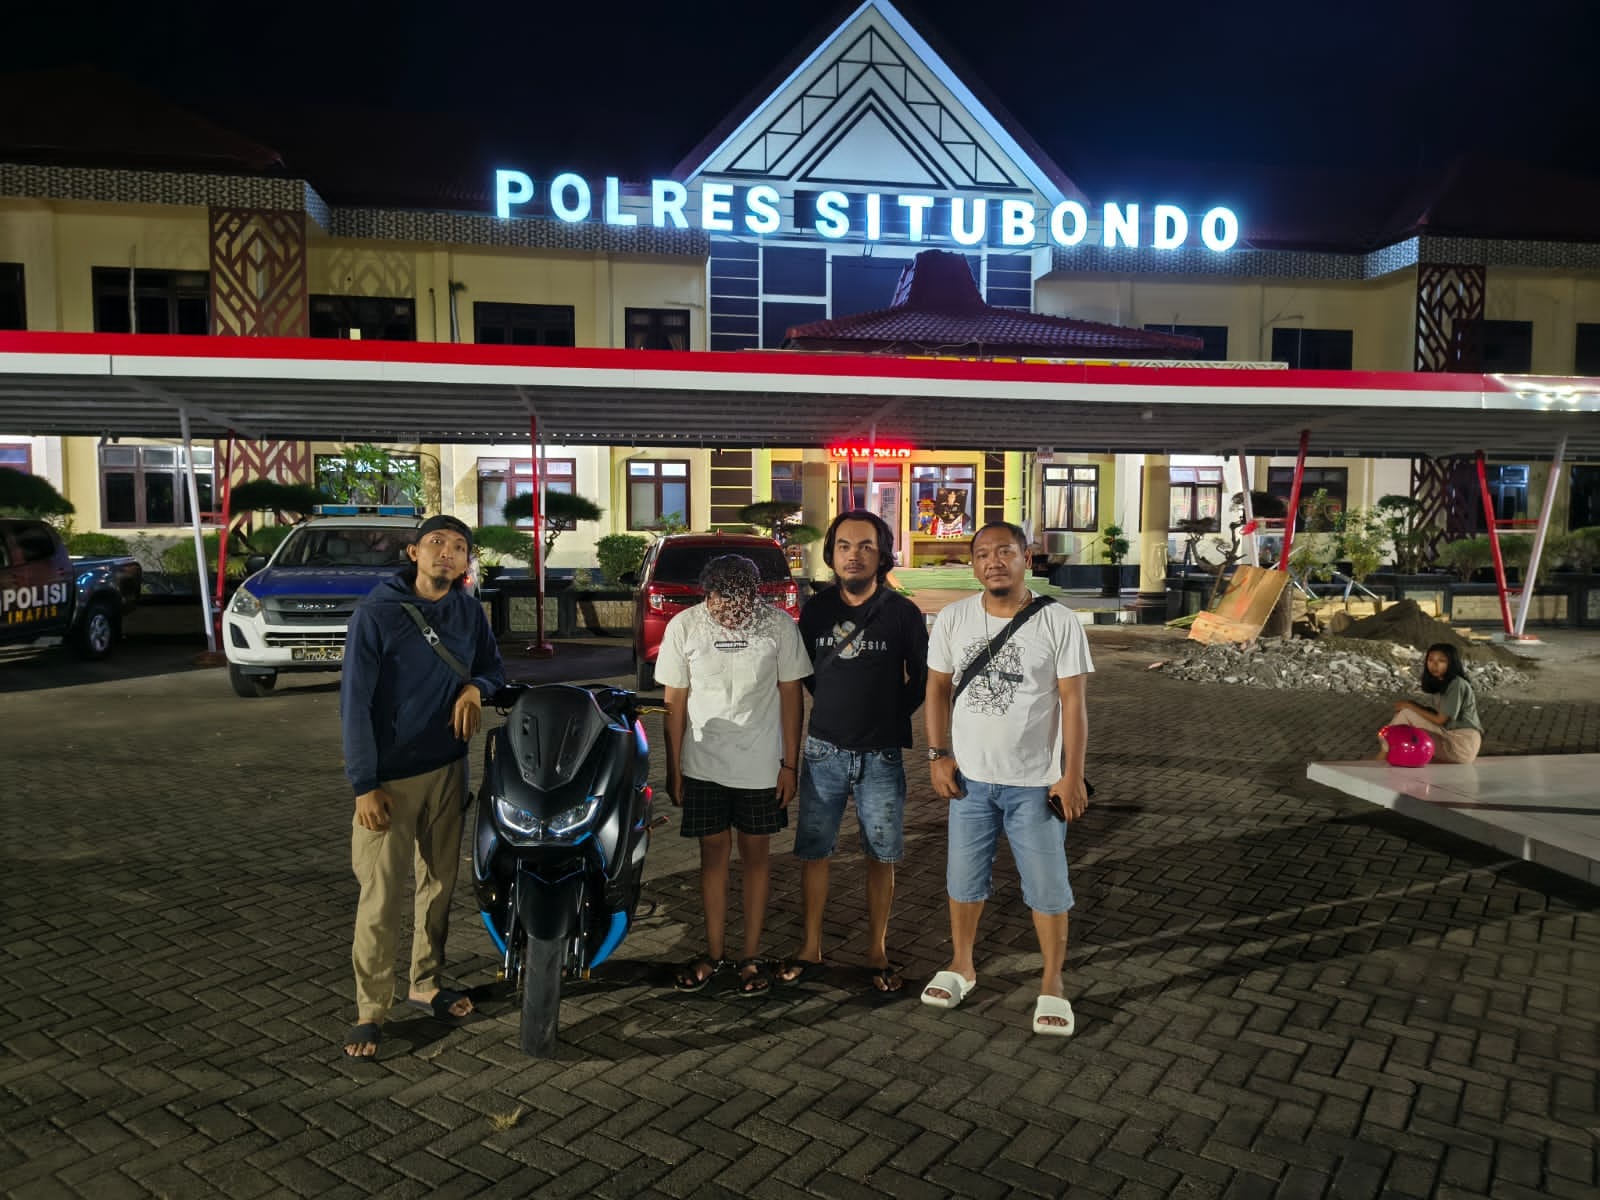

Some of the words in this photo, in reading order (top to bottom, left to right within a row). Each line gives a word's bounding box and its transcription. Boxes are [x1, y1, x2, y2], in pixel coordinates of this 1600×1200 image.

[496, 169, 782, 234] POLRES
[815, 190, 1240, 252] SITUBONDO
[3, 583, 67, 612] POLISI
[815, 636, 888, 651] INDESIA
